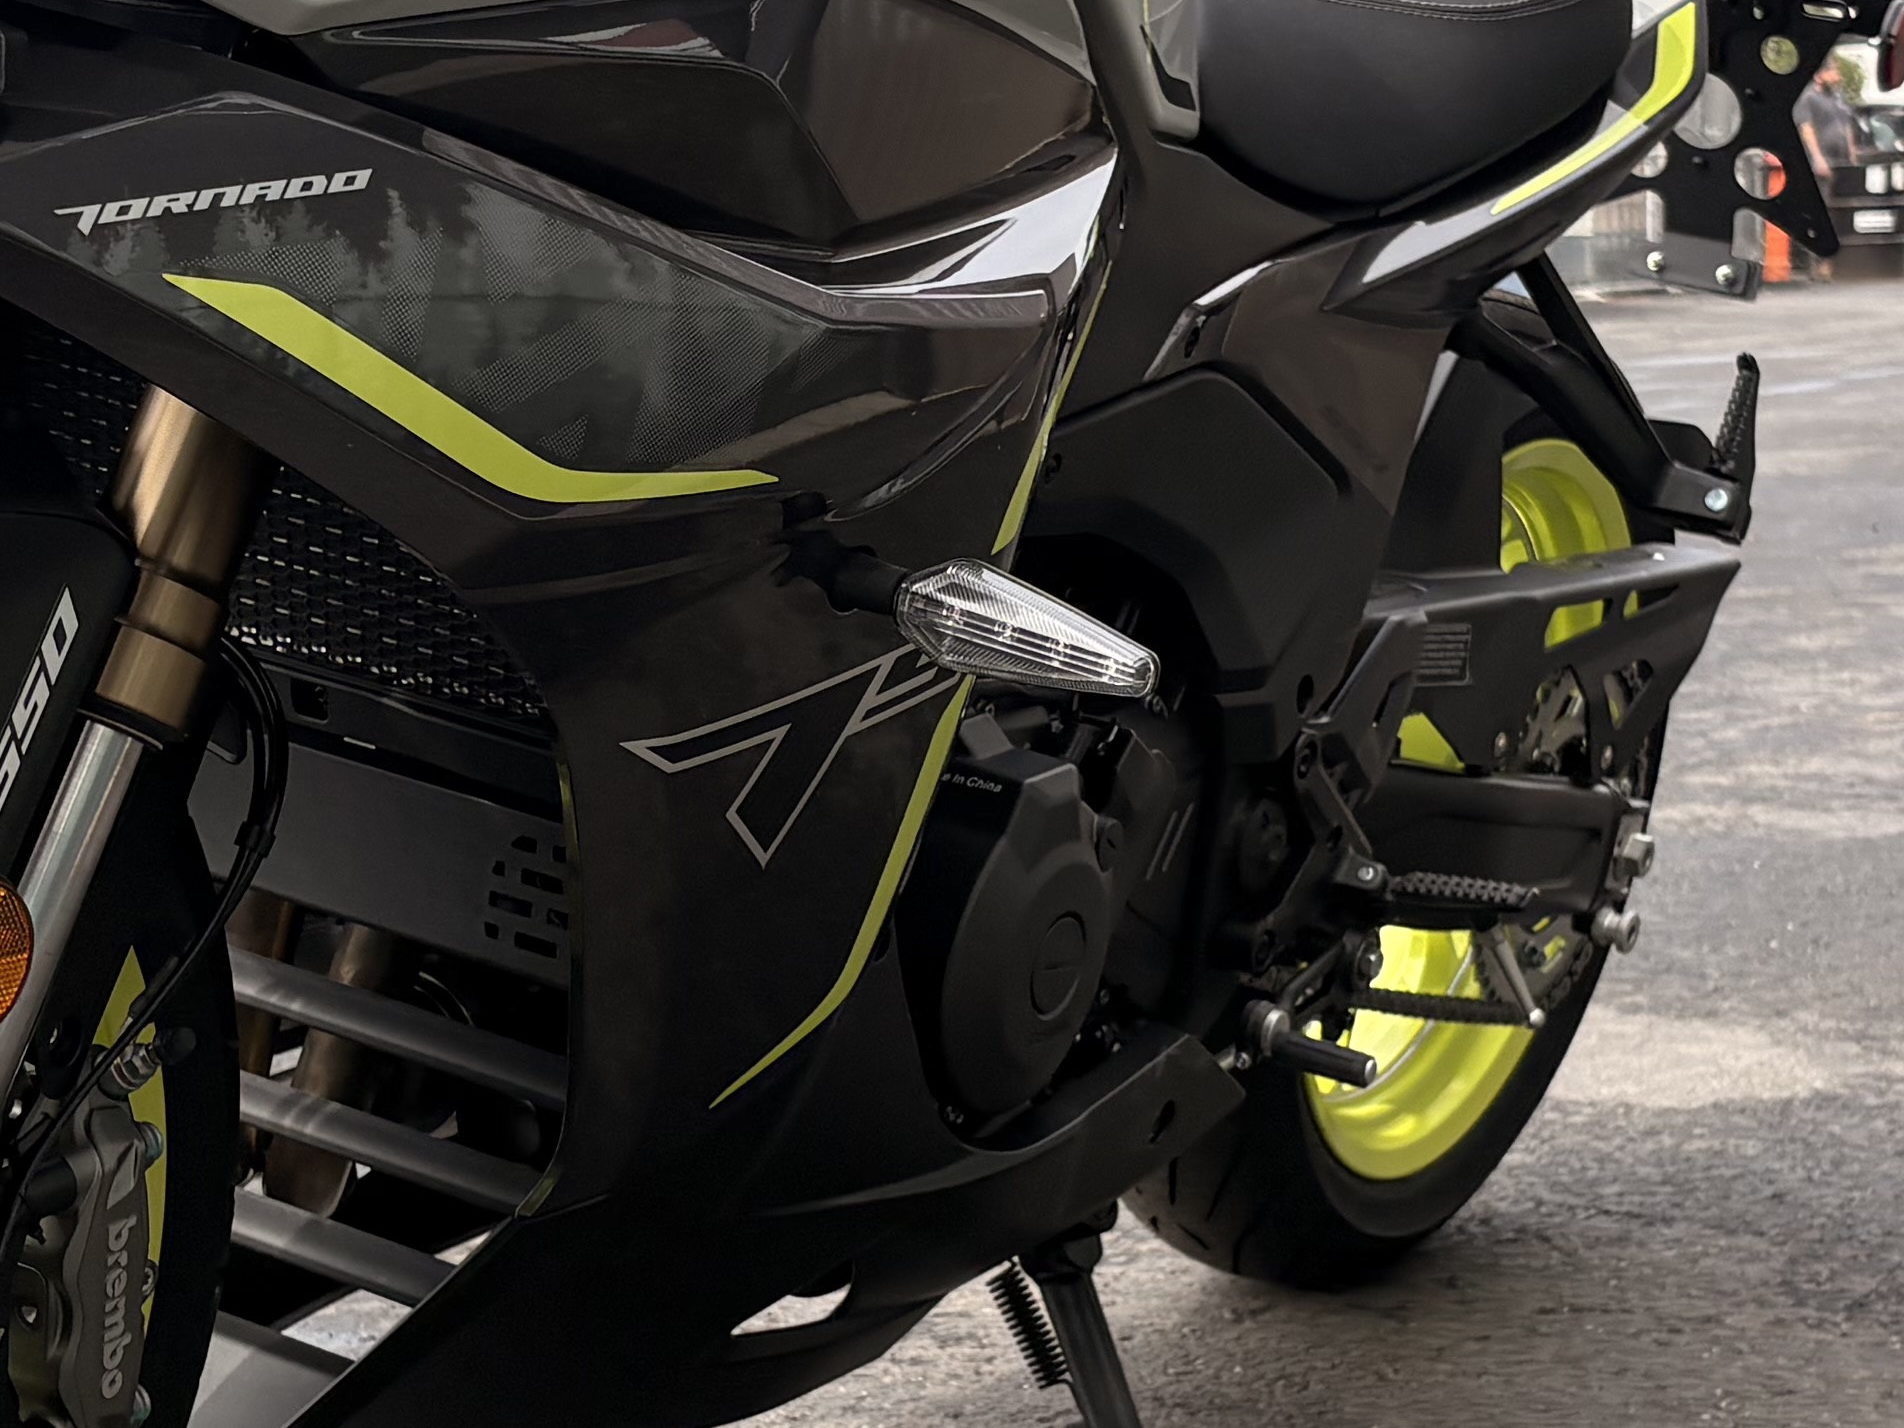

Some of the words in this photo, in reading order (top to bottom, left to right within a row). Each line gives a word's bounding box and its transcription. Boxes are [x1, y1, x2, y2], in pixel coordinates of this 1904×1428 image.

[53, 168, 373, 237] TORNADO
[966, 776, 1003, 792] China
[101, 1213, 138, 1400] brembo
